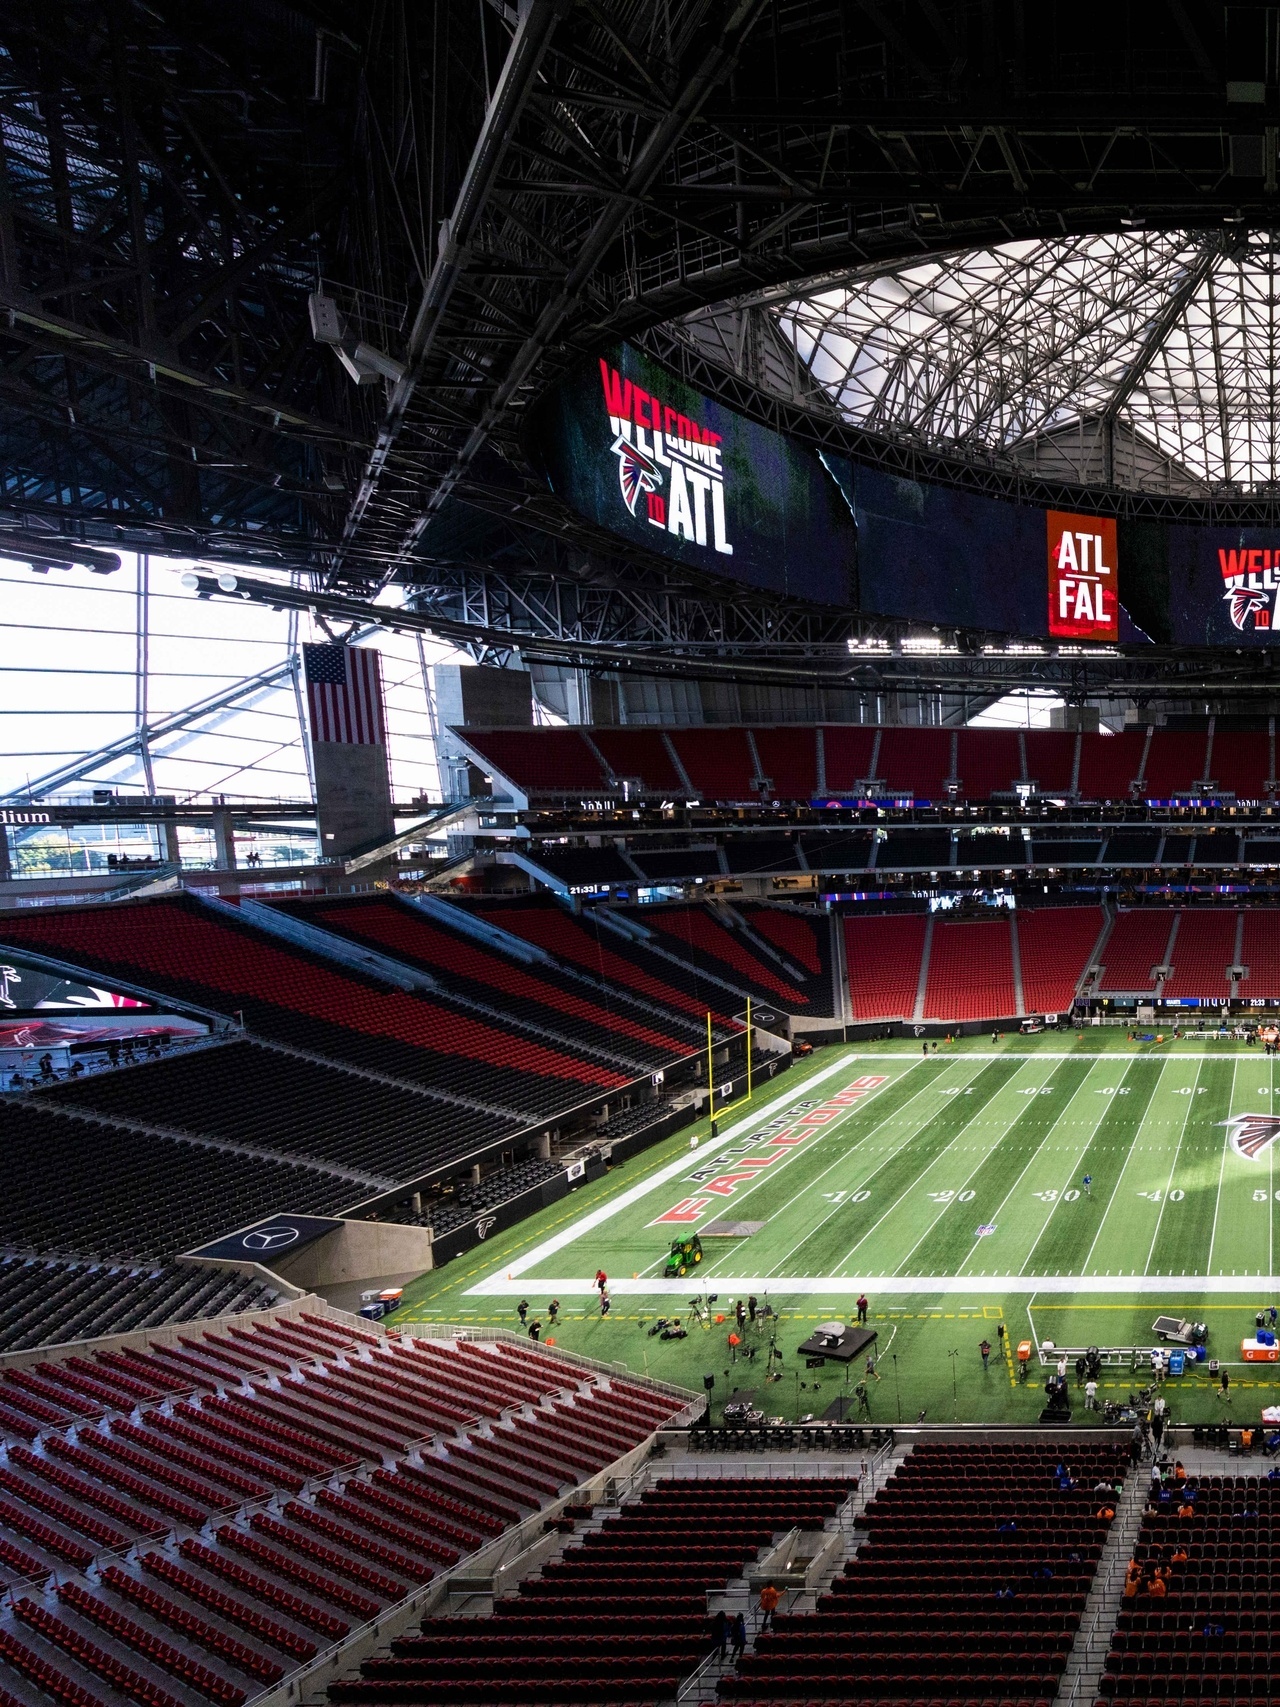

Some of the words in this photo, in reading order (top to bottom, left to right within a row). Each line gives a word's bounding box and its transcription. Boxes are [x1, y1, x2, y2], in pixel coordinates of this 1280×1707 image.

[600, 358, 723, 472] WELCOME
[646, 492, 665, 525] TO
[667, 460, 733, 555] ATL
[1058, 531, 1110, 574] ATL
[1059, 579, 1111, 622] FAL
[1255, 611, 1269, 626] TO
[570, 886, 594, 894] 21:33
[680, 1099, 823, 1182] ATLANTA
[643, 1075, 890, 1229] FALCONS
[827, 1190, 872, 1202] 10
[933, 1190, 976, 1202] 20
[1040, 1190, 1080, 1202] 30
[1146, 1190, 1185, 1202] 40
[1246, 1351, 1254, 1359] G
[1268, 1351, 1276, 1359] G
